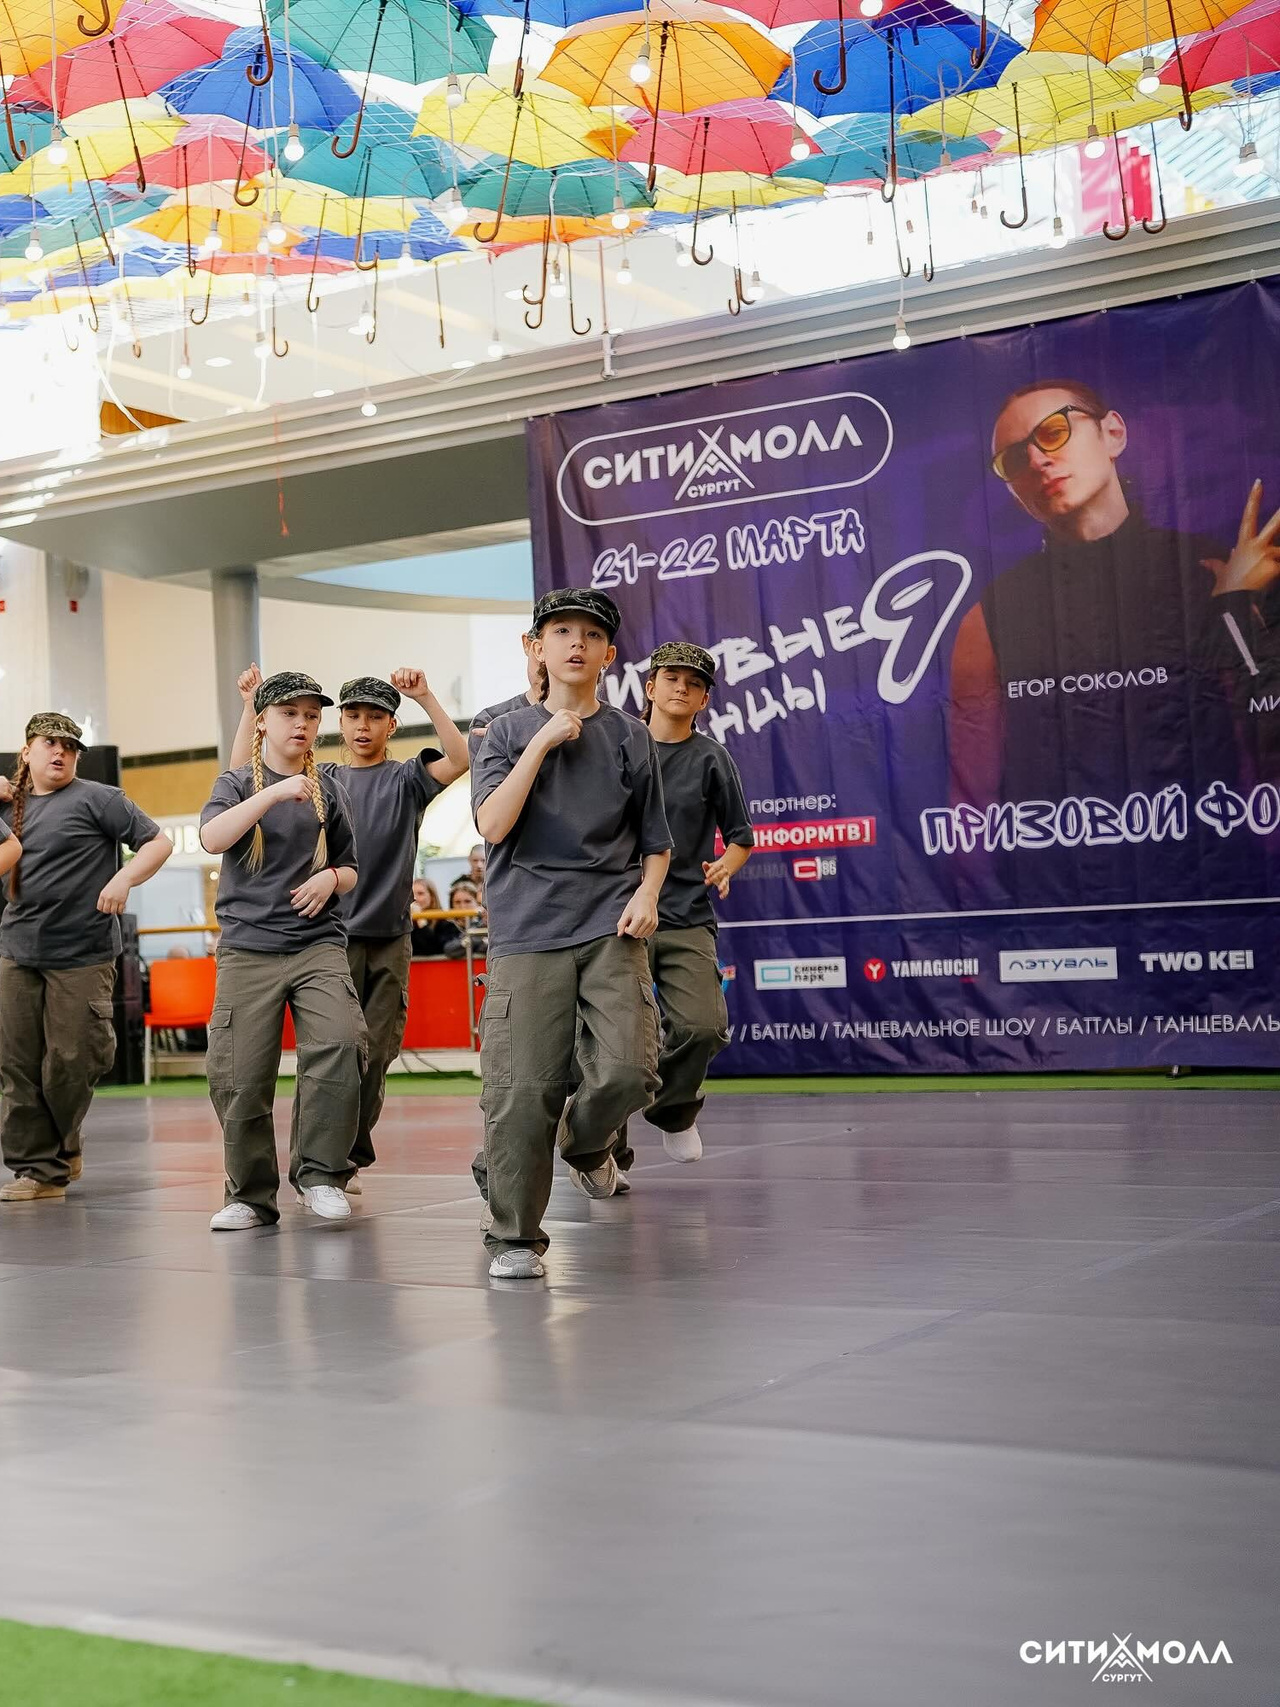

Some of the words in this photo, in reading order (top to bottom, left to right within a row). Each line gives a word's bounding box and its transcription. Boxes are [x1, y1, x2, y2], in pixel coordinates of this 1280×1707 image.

[583, 441, 695, 490] СИТИ
[729, 413, 863, 465] МОЛЛ
[687, 478, 741, 499] СУРГУТ
[590, 533, 720, 590] 21-22
[726, 507, 867, 571] МАРТА
[1007, 677, 1056, 699] ЕГОР
[1060, 666, 1169, 693] СОКОЛОВ
[750, 793, 837, 816] партнер:
[920, 783, 1188, 856] ПРИЗОВОЙ
[891, 957, 979, 978] YAMAGUCHI
[1139, 951, 1203, 972] TWO
[1209, 949, 1255, 970] KEI
[794, 973, 825, 984] парк
[751, 1022, 816, 1041] БАТТЛЫ
[833, 1018, 981, 1040] ТАНЦЕВАЛЬНОЕ
[985, 1016, 1036, 1037] ШОУ
[1056, 1016, 1133, 1035] БАТТЛЫ
[1153, 1013, 1280, 1035] ТАНЦЕВАЛЬ
